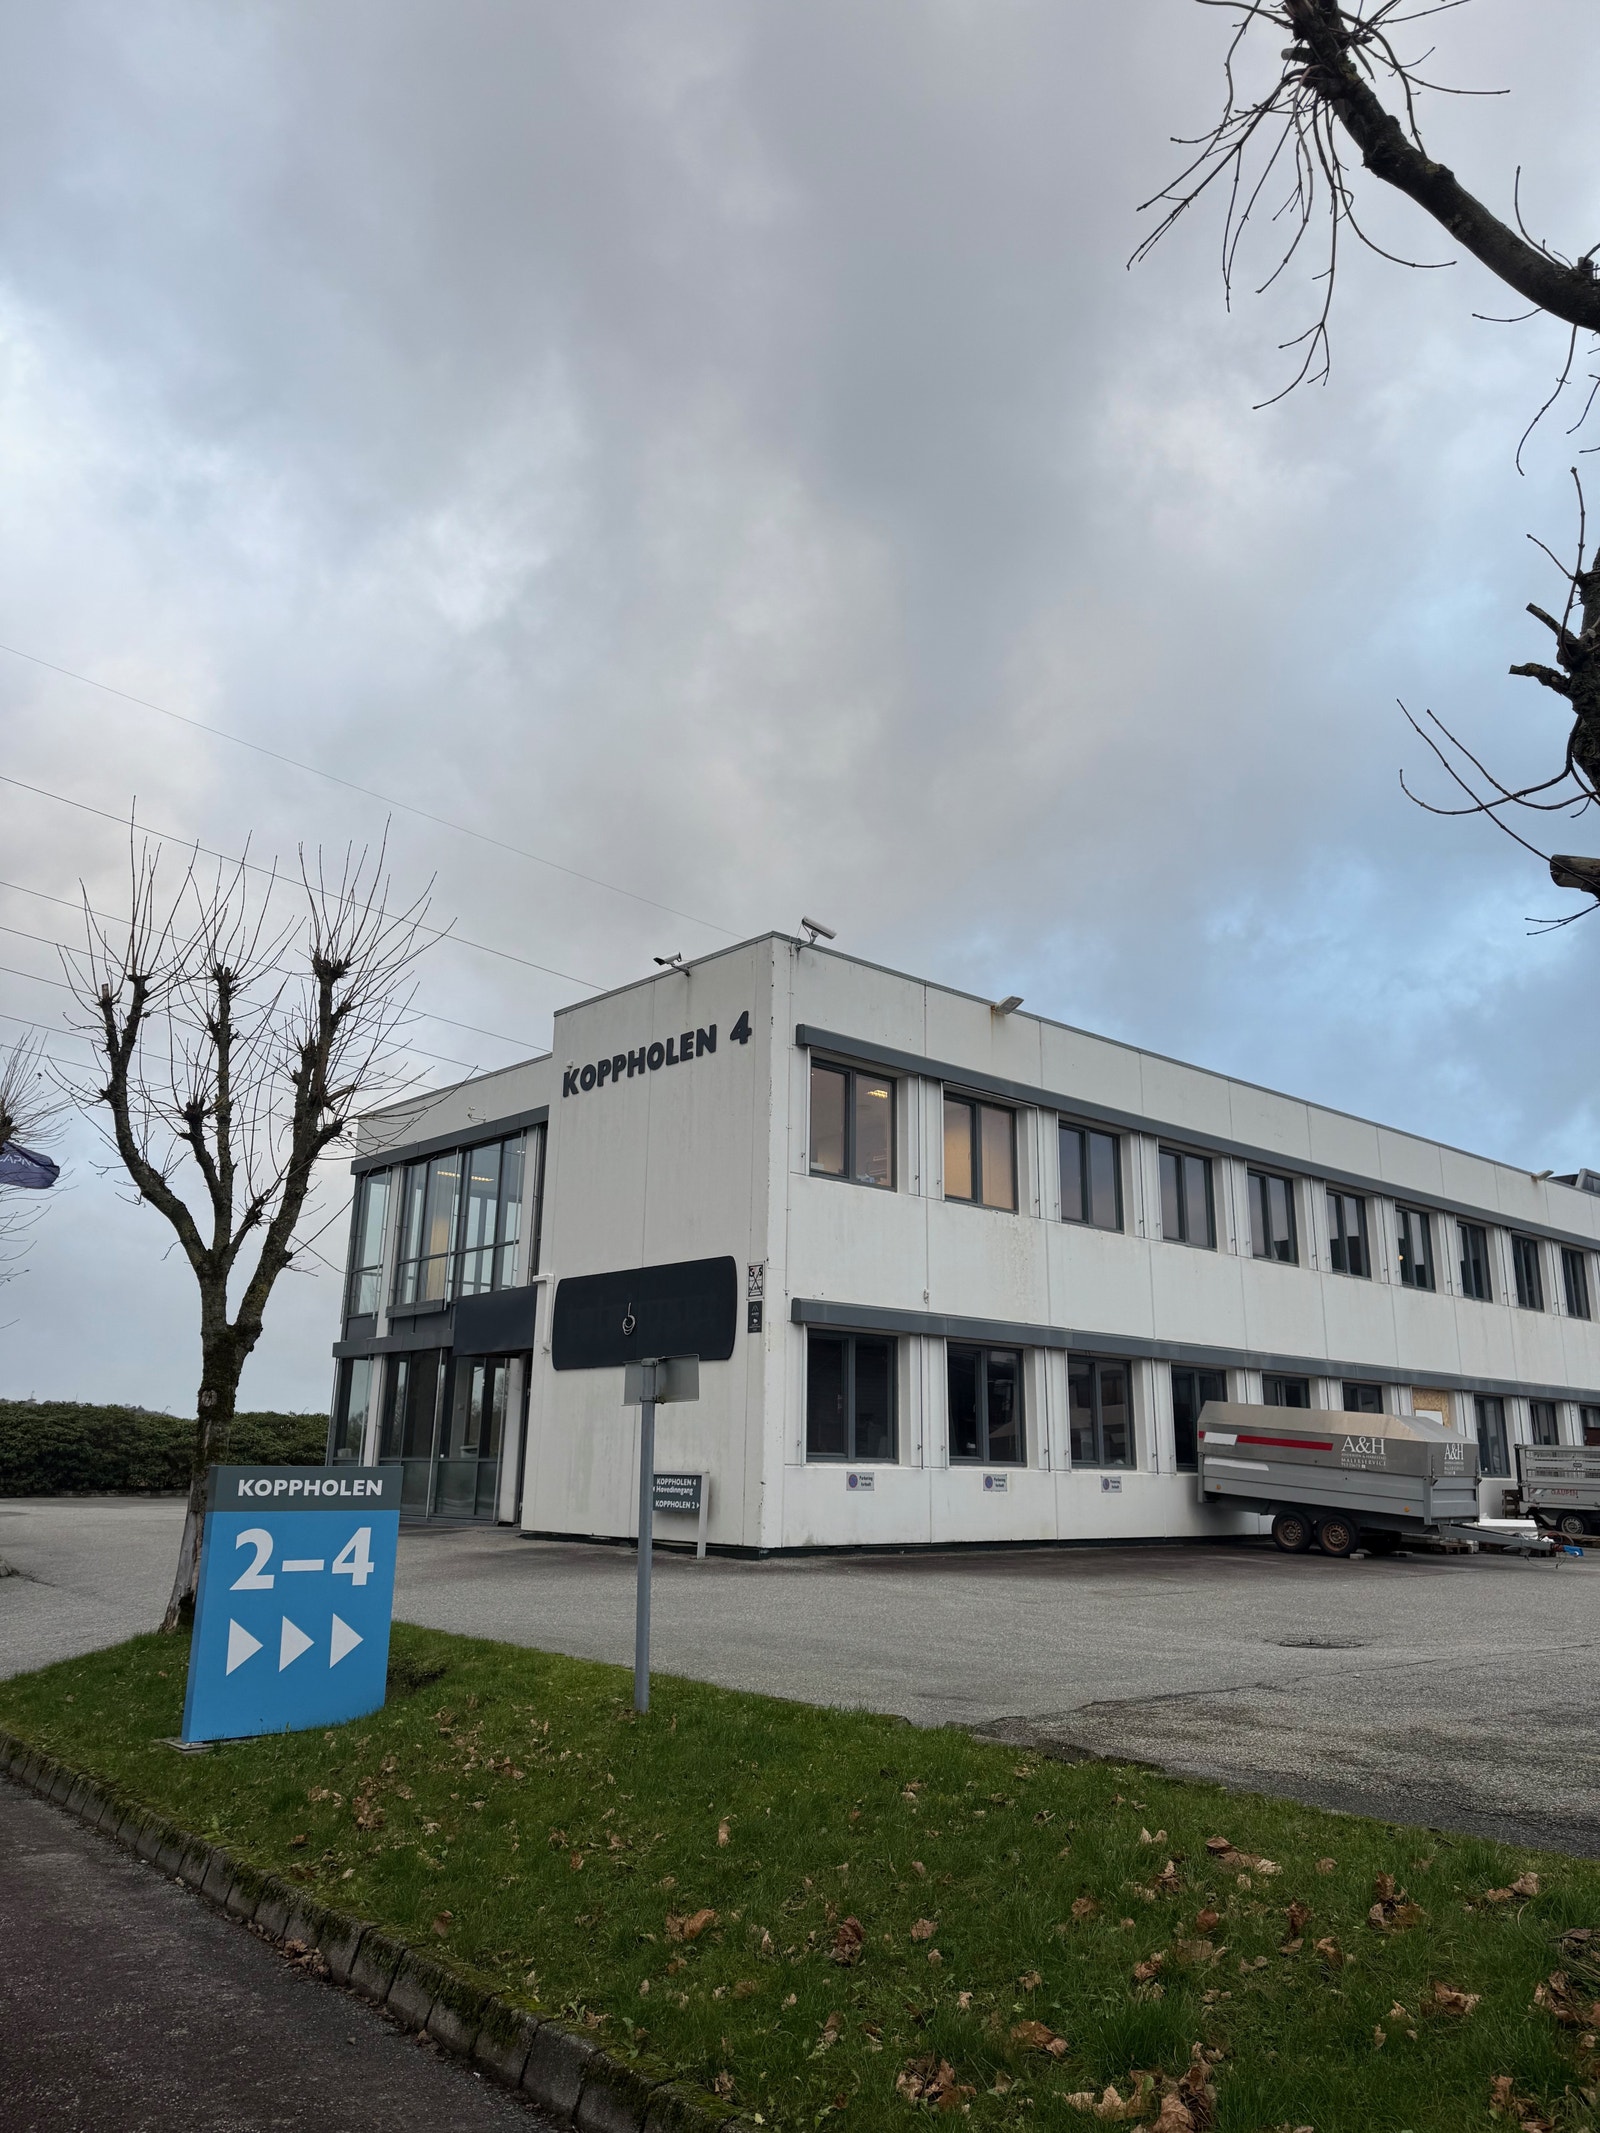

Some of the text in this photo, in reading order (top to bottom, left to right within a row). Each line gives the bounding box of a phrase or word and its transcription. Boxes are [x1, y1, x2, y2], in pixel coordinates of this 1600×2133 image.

[562, 1010, 752, 1098] KOPPHOLEN 4
[1341, 1435, 1386, 1455] A&H
[1444, 1443, 1464, 1460] A&H
[237, 1479, 383, 1496] KOPPHOLEN
[655, 1500, 696, 1509] KOPPHOLEN 2
